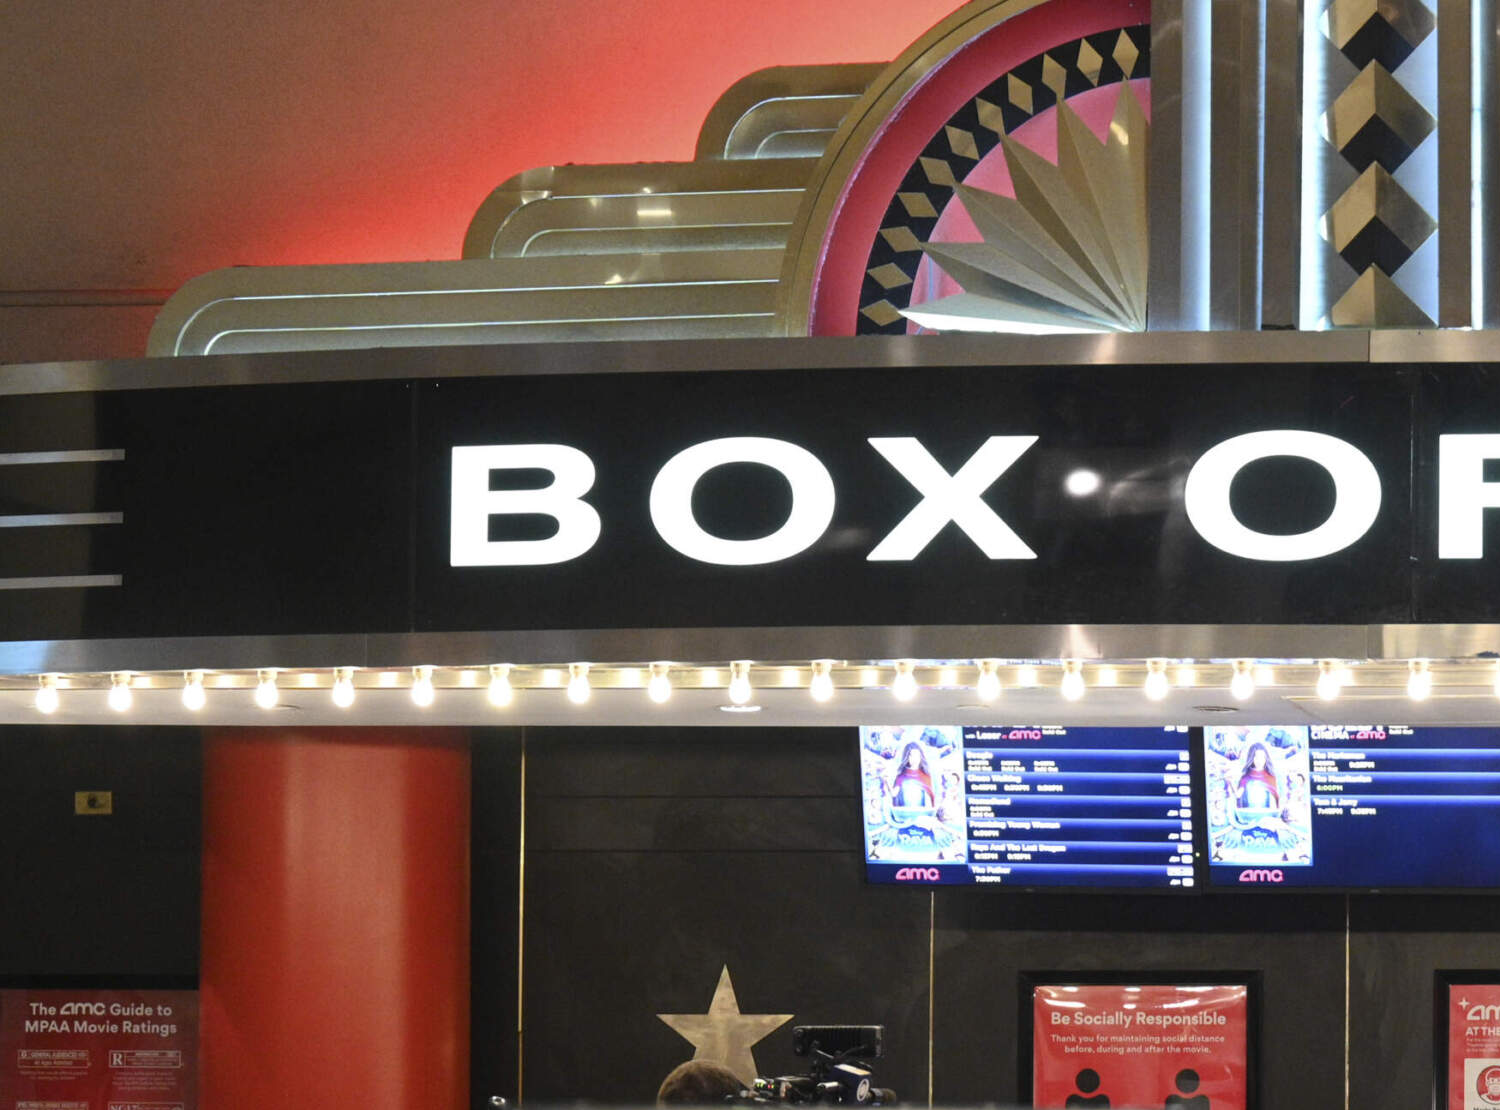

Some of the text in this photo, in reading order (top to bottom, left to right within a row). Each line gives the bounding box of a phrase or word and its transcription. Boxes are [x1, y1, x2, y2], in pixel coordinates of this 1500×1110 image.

[450, 435, 1038, 567] BOX
[1008, 729, 1042, 740] amc
[1356, 730, 1387, 740] amc
[896, 868, 940, 881] amc
[1239, 870, 1283, 882] amc
[30, 1002, 172, 1016] The amc Guide to
[1051, 1012, 1227, 1029] Be Socially Responsible
[25, 1020, 177, 1037] MPAA Movie Ratings
[1465, 1027, 1482, 1036] AT
[1051, 1034, 1225, 1046] Thank you for maintaining social distance
[1064, 1045, 1212, 1056] before, during and after the movie.
[112, 1052, 123, 1065] R
